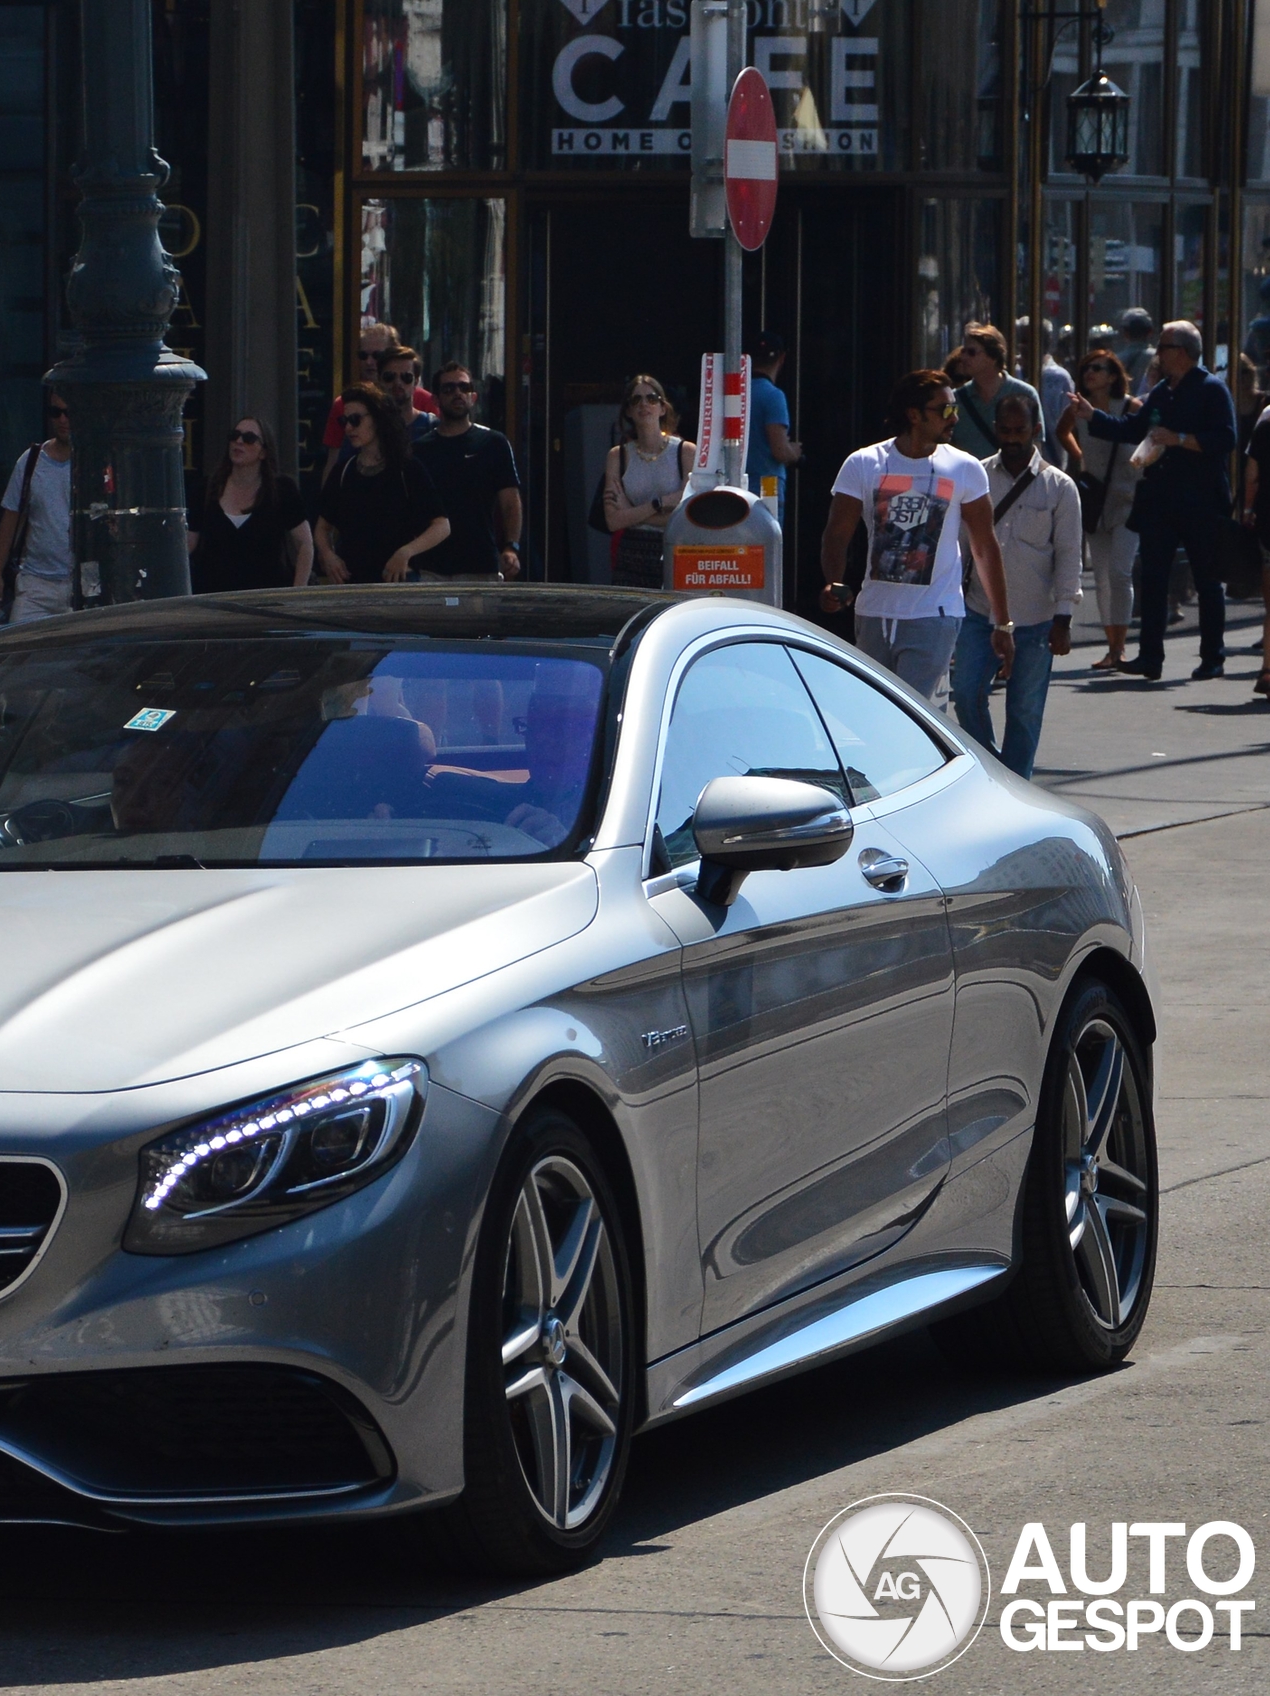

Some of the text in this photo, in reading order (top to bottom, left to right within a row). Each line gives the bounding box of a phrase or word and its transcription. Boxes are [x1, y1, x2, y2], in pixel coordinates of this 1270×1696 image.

[558, 132, 653, 150] HOME
[698, 560, 739, 570] BEIFALL
[685, 572, 751, 584] FÜR ABFALL!
